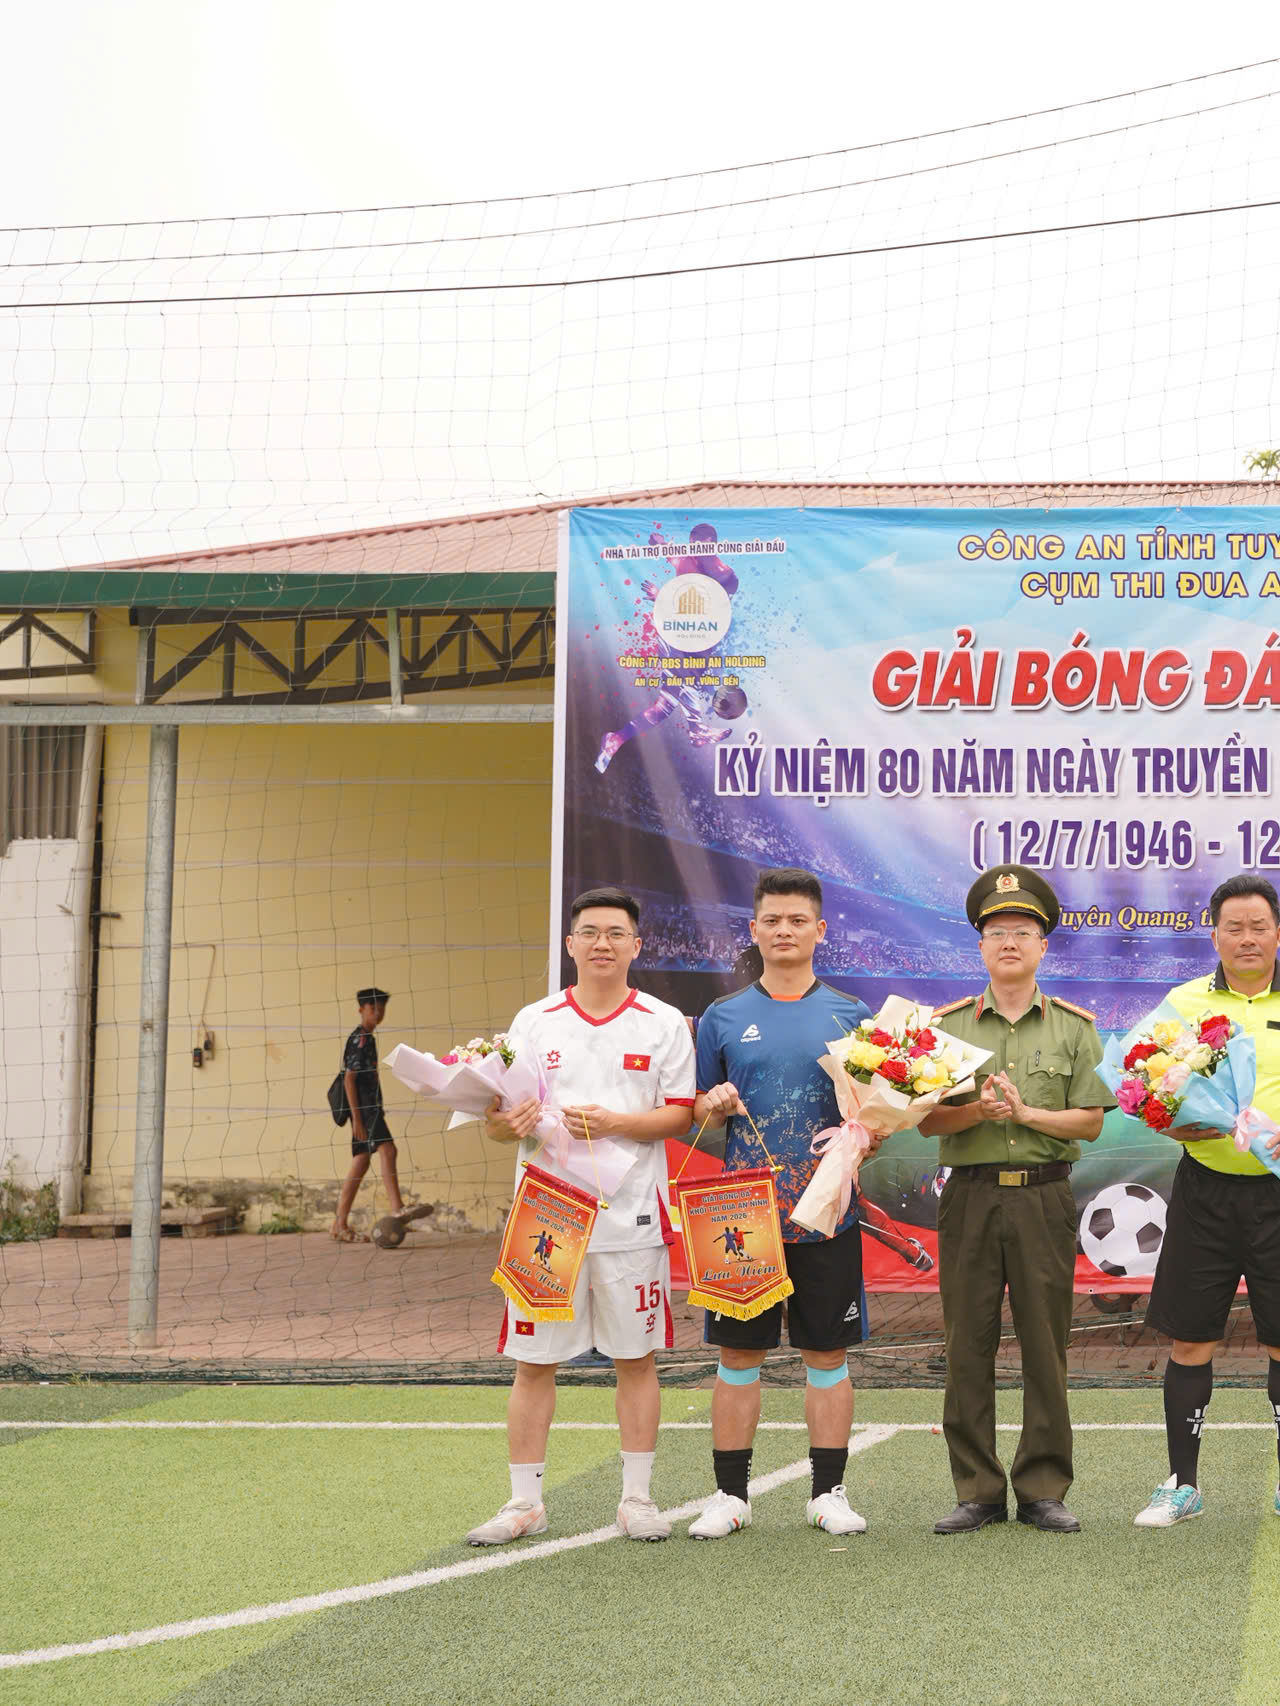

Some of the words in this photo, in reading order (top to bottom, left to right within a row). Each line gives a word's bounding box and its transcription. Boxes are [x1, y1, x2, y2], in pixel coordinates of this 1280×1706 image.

[605, 547, 624, 559] NHÀ
[690, 541, 715, 554] HÀNH
[717, 540, 743, 553] CÙNG
[958, 529, 1065, 561] CÔNG
[1076, 534, 1126, 560] AN
[1136, 526, 1215, 560] TỈNH
[1021, 571, 1099, 605] CỤM
[1110, 572, 1164, 599] THI
[1177, 572, 1249, 598] ĐUA
[697, 621, 718, 631] AN
[619, 655, 645, 668] CÔNG
[648, 656, 659, 668] TY
[683, 656, 706, 668] BÌNH
[708, 656, 721, 668] AN
[725, 655, 766, 668] HOLDING
[872, 628, 1000, 707] GIẢI
[1011, 632, 1191, 707] BÓNG
[635, 677, 646, 687] AN
[718, 731, 763, 793] KỶ
[775, 738, 865, 803] NIỆM
[878, 748, 920, 793] 80
[932, 738, 1014, 793] NĂM
[1027, 738, 1122, 793] NGÀY
[1132, 732, 1268, 793] TRUYỀN
[1060, 906, 1112, 931] uyên
[1117, 906, 1194, 931] Quang,
[708, 1205, 720, 1213] THI
[737, 1201, 748, 1209] AN
[750, 1199, 768, 1208] NINH
[730, 1212, 748, 1221] 2026
[634, 1280, 660, 1312] 15
